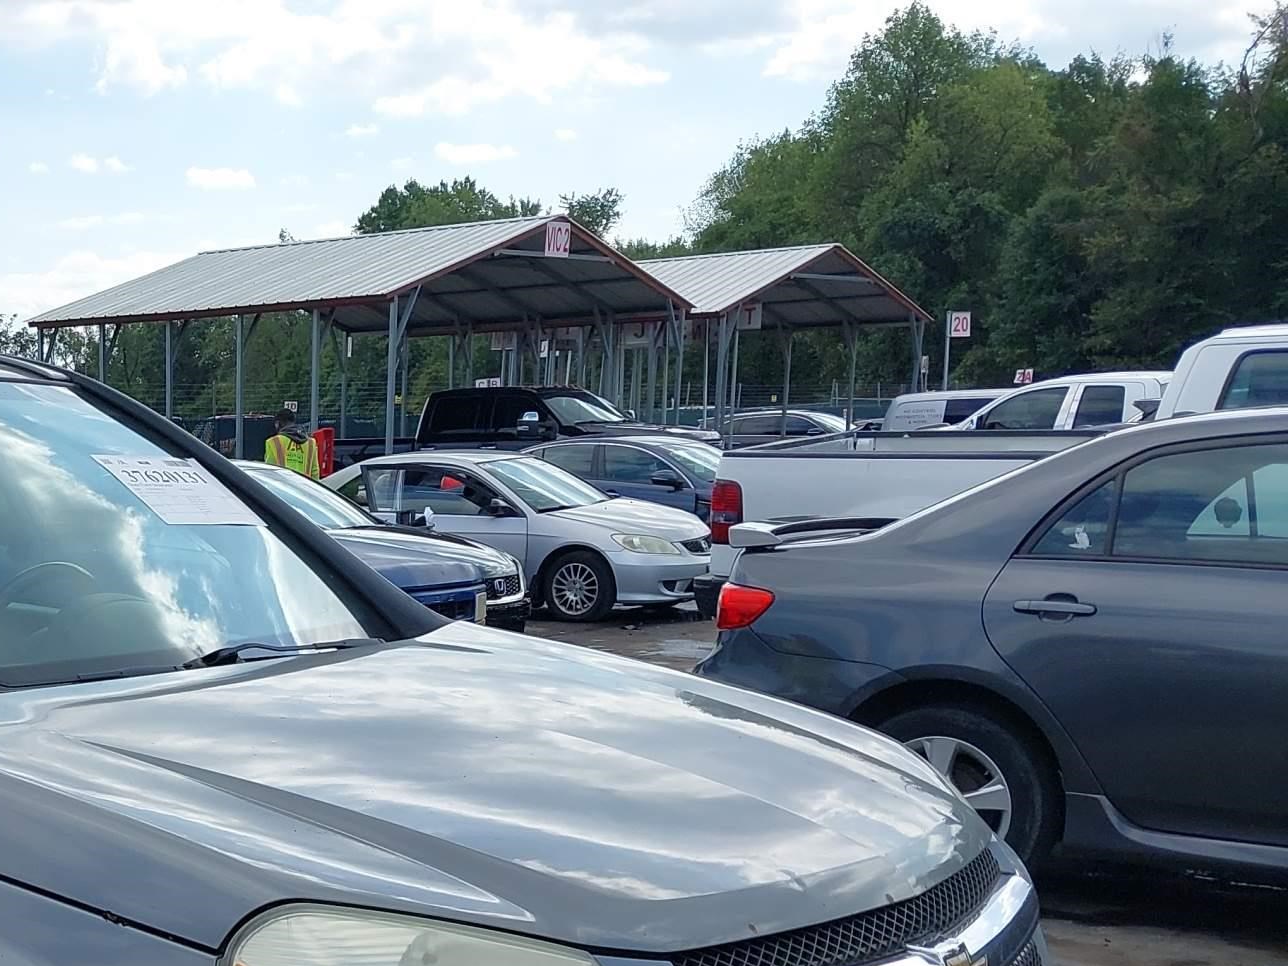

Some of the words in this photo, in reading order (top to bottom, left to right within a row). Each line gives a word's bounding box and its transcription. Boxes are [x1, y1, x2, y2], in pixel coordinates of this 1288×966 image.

[547, 225, 562, 252] VIC
[563, 228, 570, 252] 2
[953, 316, 969, 333] 20
[121, 469, 208, 484] 37620131
